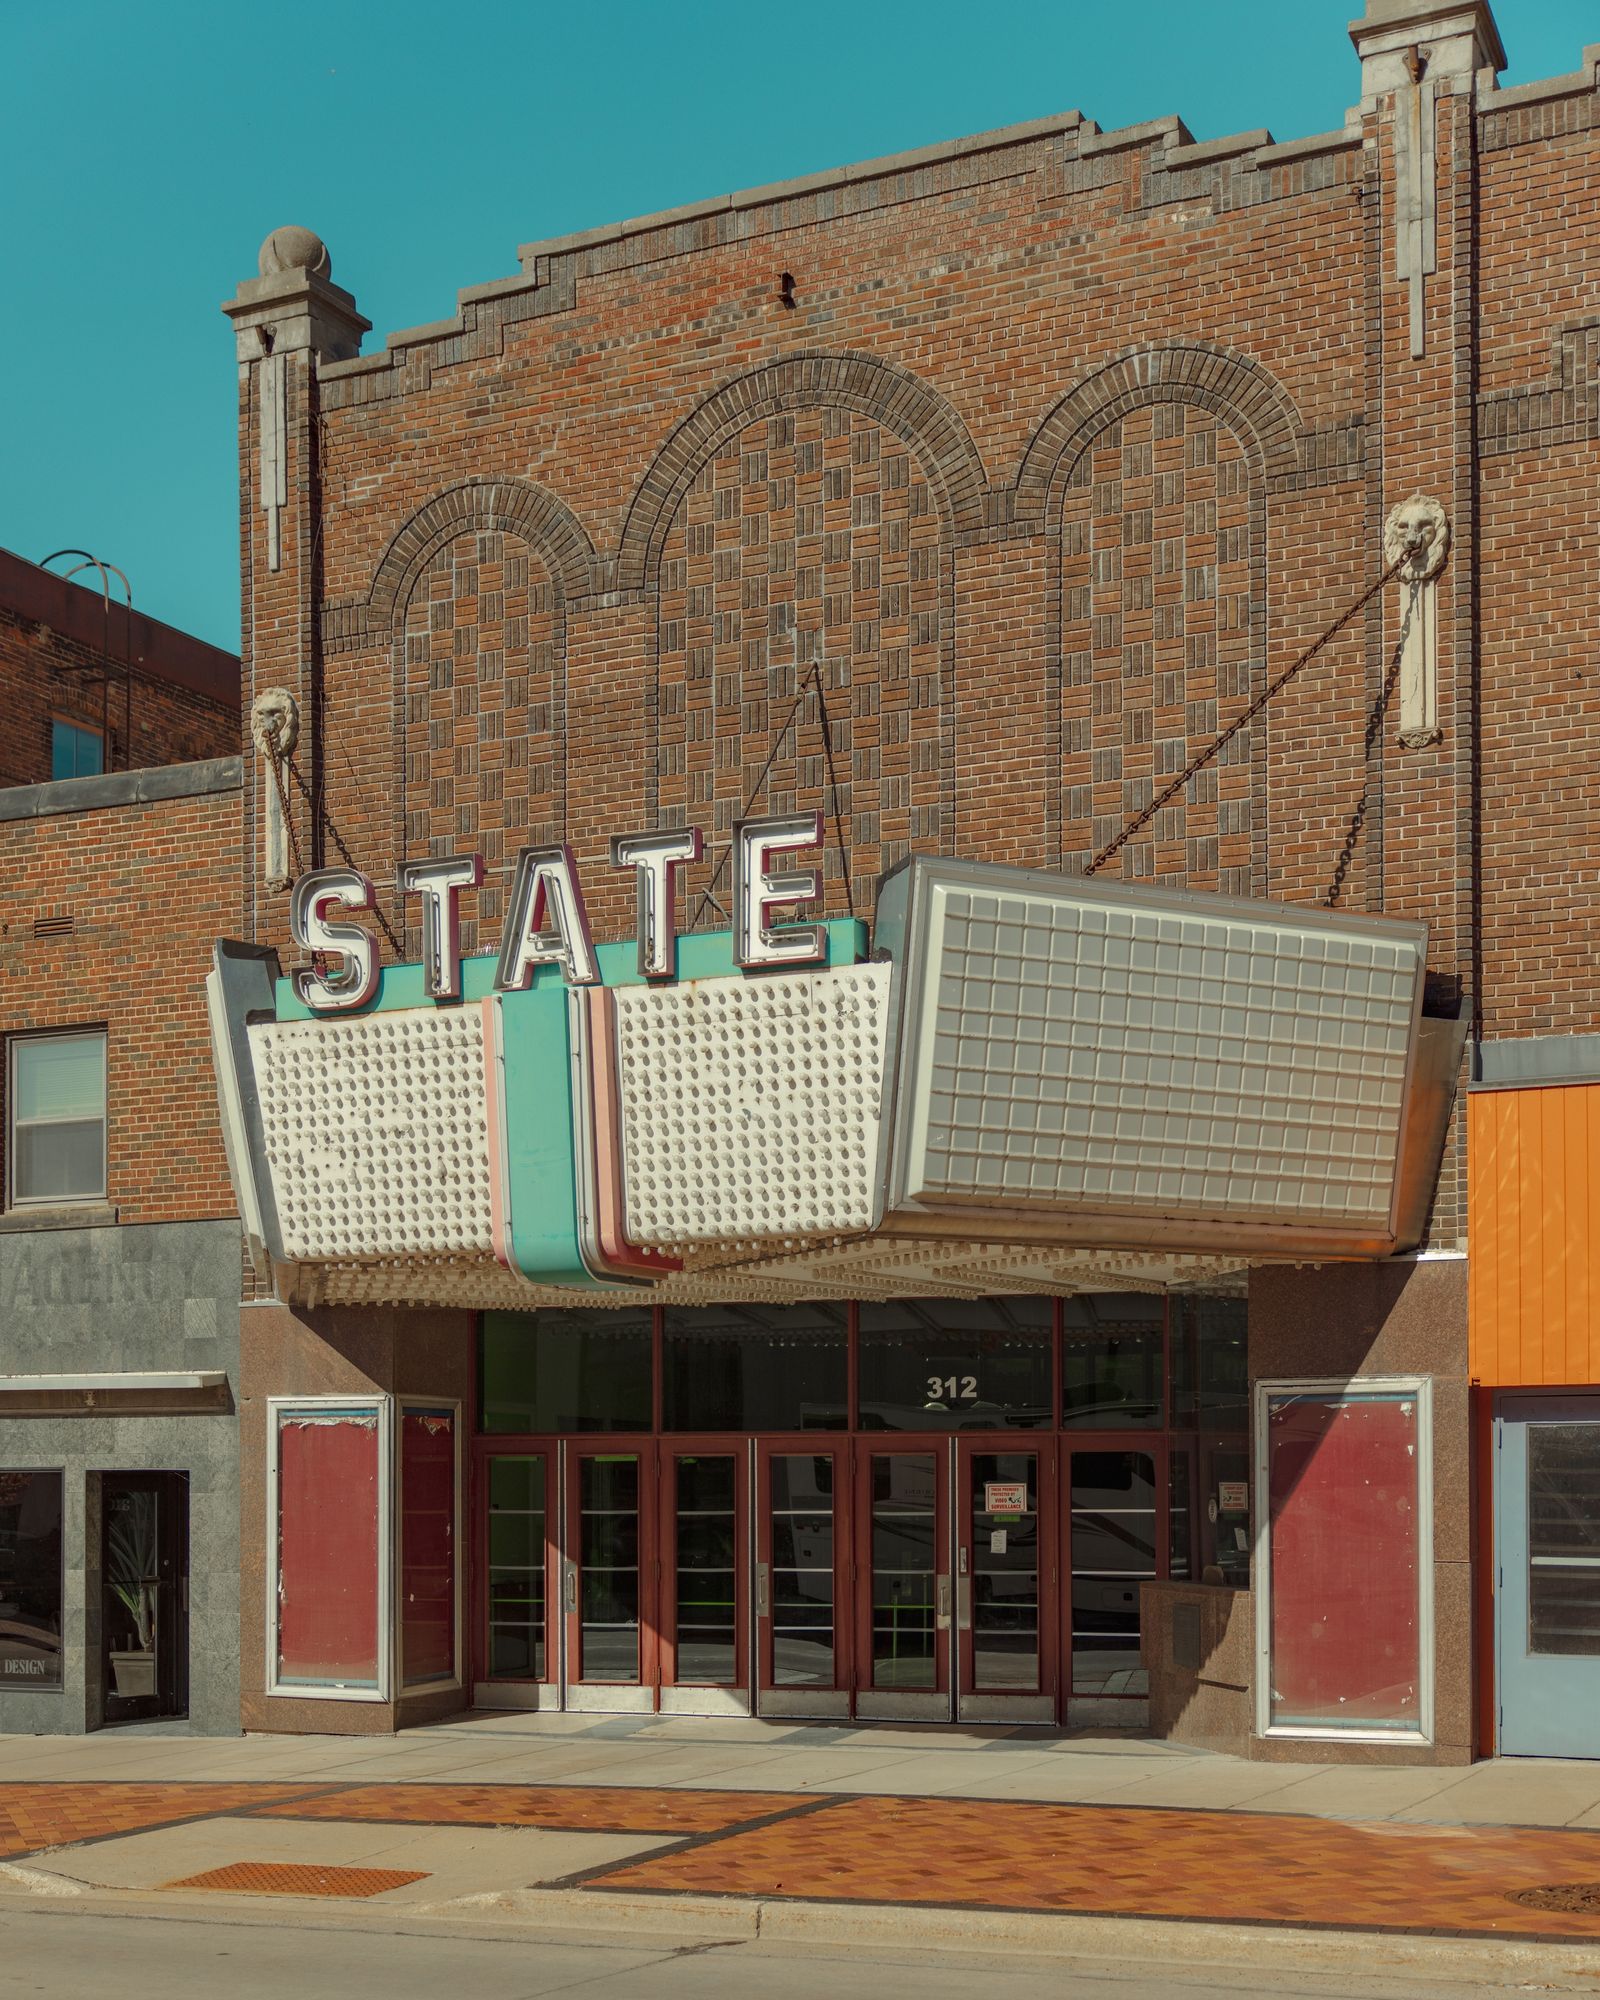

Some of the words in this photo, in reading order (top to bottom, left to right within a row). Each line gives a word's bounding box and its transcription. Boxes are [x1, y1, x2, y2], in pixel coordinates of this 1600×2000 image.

[291, 809, 826, 1010] STATE
[926, 1376, 977, 1398] 312
[4, 1659, 45, 1675] DESIGN
